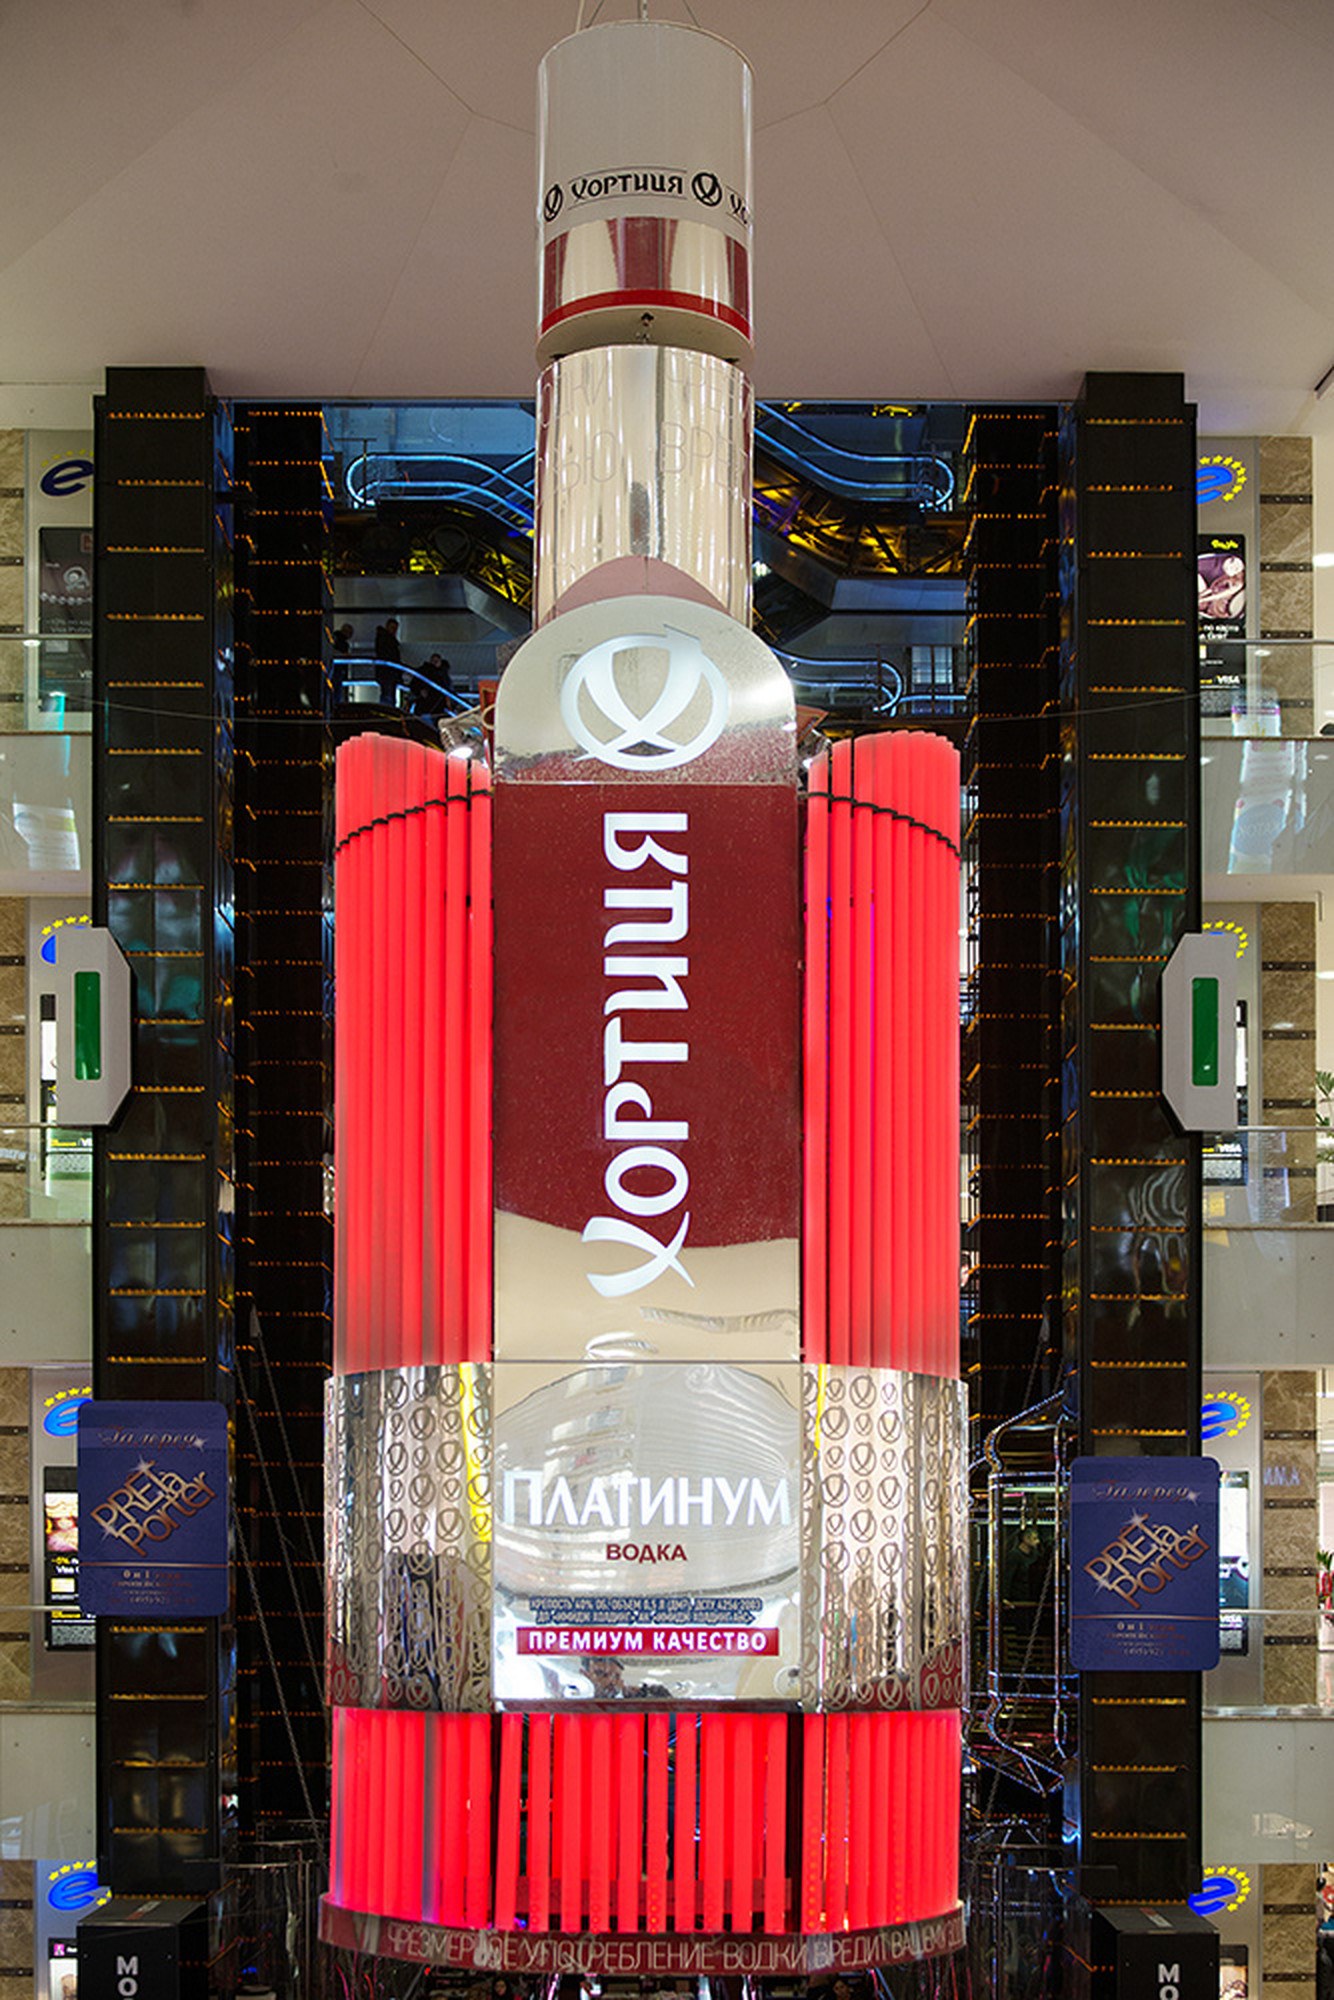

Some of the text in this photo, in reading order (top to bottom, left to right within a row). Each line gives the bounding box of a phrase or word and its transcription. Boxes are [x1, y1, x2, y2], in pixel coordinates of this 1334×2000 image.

[581, 812, 696, 1297] ХОРТИЦЯ
[504, 1470, 792, 1526] ПЛАТИНУМ
[606, 1544, 687, 1563] ВОДКА
[529, 1631, 767, 1651] ПРЕМИУМ КАЧЕСТВО
[387, 1921, 518, 1971] ЧРЕЗМЕРОЕ
[723, 1941, 808, 1971] ВОДКИ
